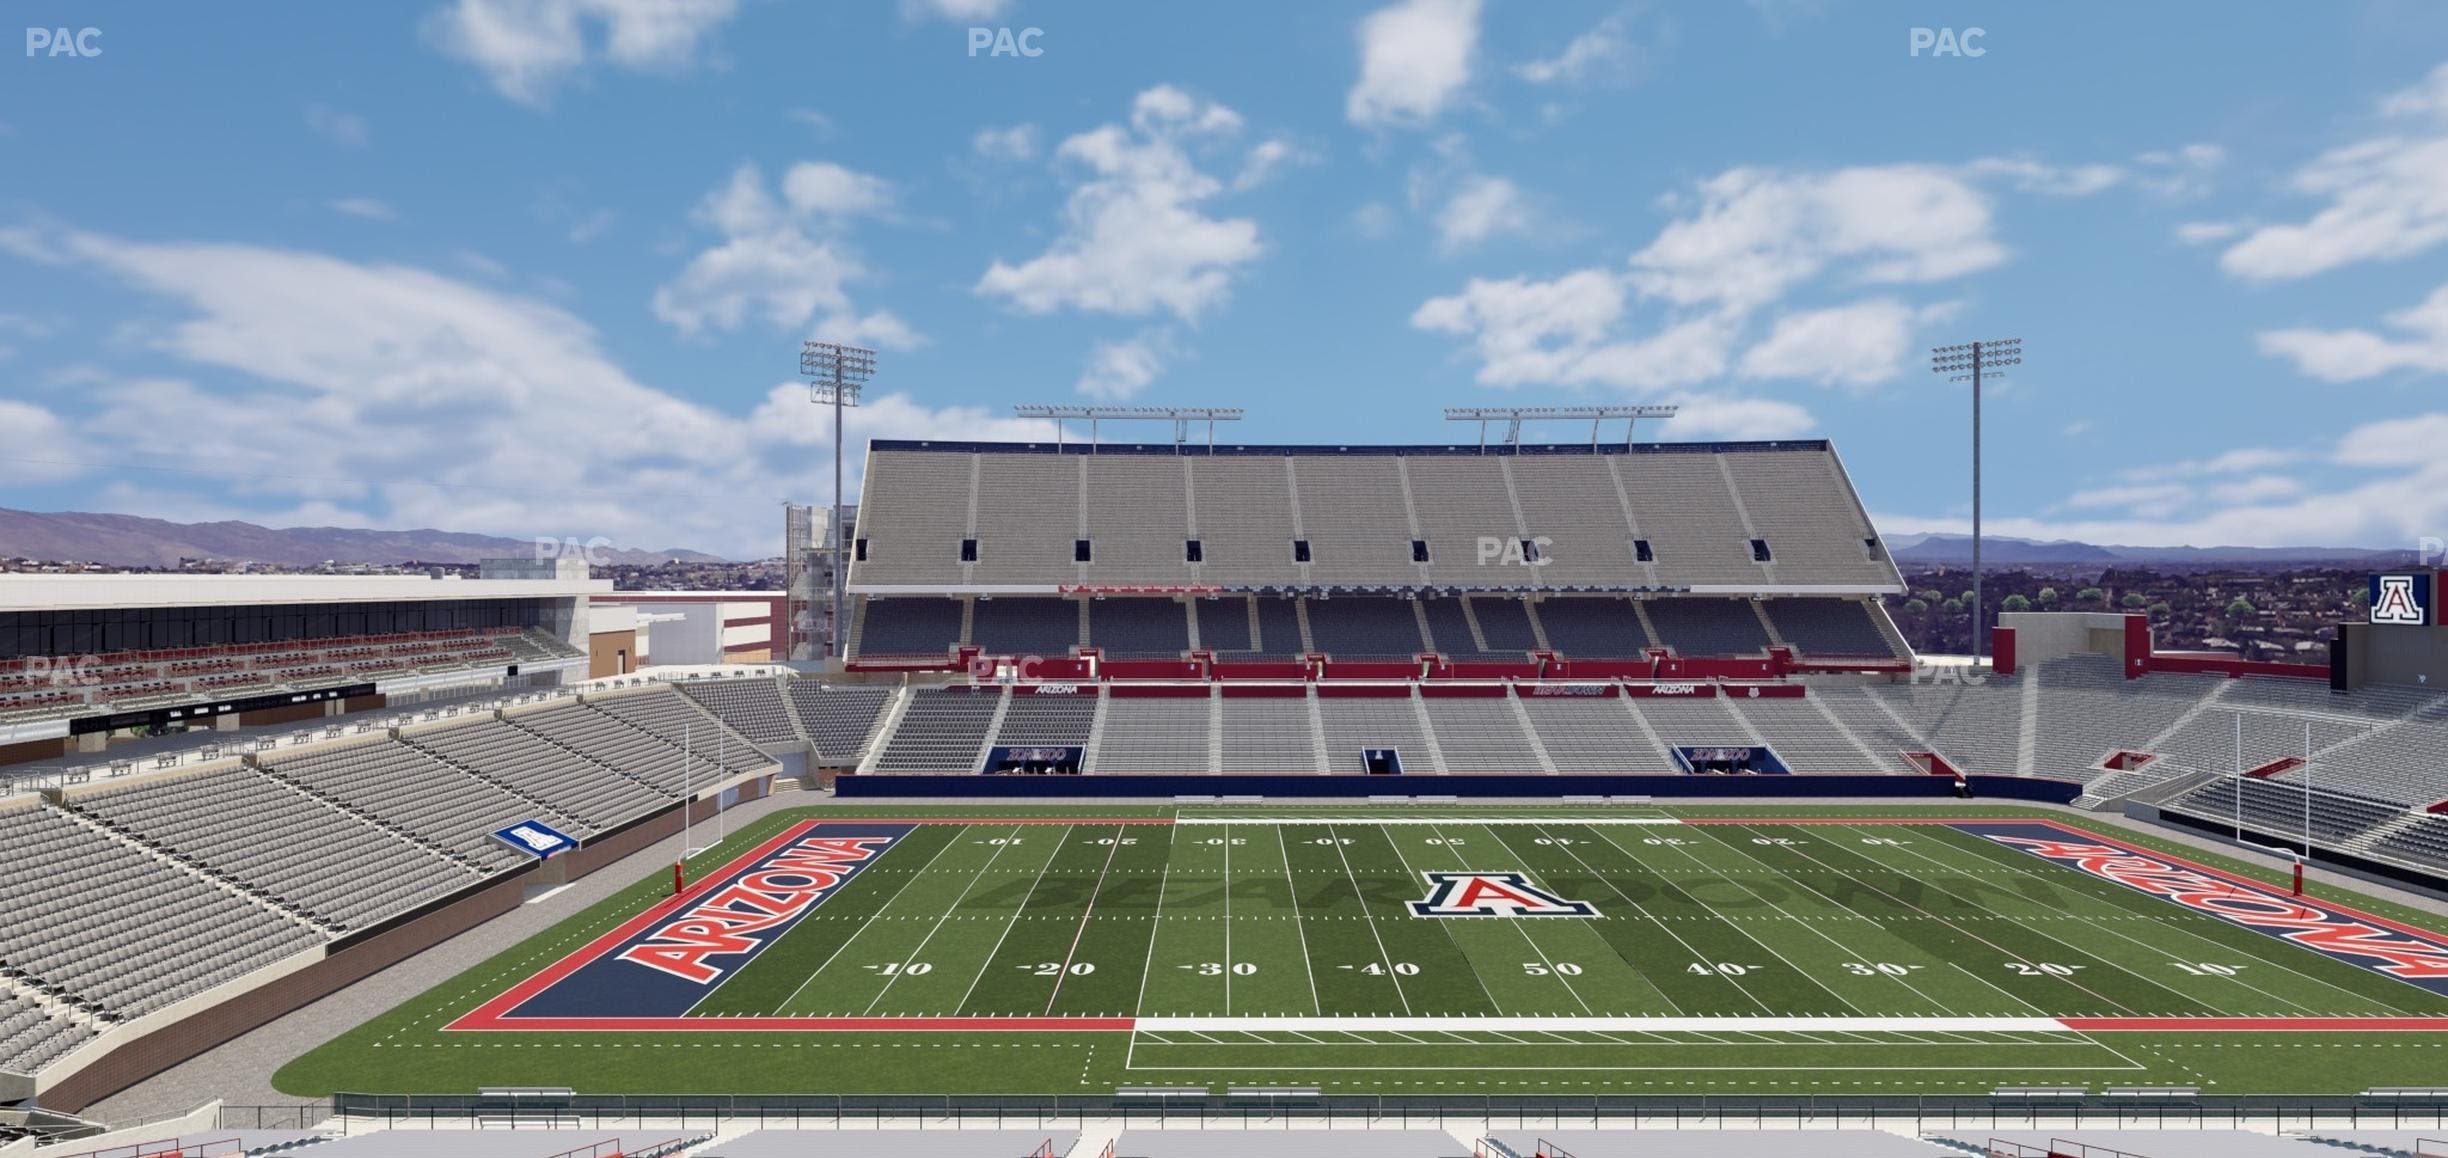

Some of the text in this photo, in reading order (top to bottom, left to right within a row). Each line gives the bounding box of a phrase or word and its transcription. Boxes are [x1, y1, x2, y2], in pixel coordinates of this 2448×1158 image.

[2371, 576, 2424, 624] A
[1035, 684, 1077, 694] ARIZONA
[1652, 684, 1695, 694] ARIZONA
[988, 838, 1025, 846] 10
[1097, 838, 1139, 846] 20
[1207, 838, 1247, 846] 30
[1315, 838, 1356, 846] 40
[1425, 838, 1466, 846] 50
[1534, 838, 1574, 846] 40
[1643, 838, 1686, 846] 30
[1752, 838, 1796, 846] 20
[1861, 838, 1900, 846] 10
[1404, 871, 1605, 918] A
[614, 837, 893, 985] ARIZONA
[875, 962, 933, 976] 10
[1033, 962, 1096, 976] 20
[1198, 962, 1257, 976] 30
[1360, 962, 1420, 976] 40
[1522, 962, 1583, 976] 50
[1686, 962, 1747, 976] 40
[1841, 962, 1909, 976] 30
[2004, 962, 2074, 976] 20
[2168, 962, 2237, 976] 10
